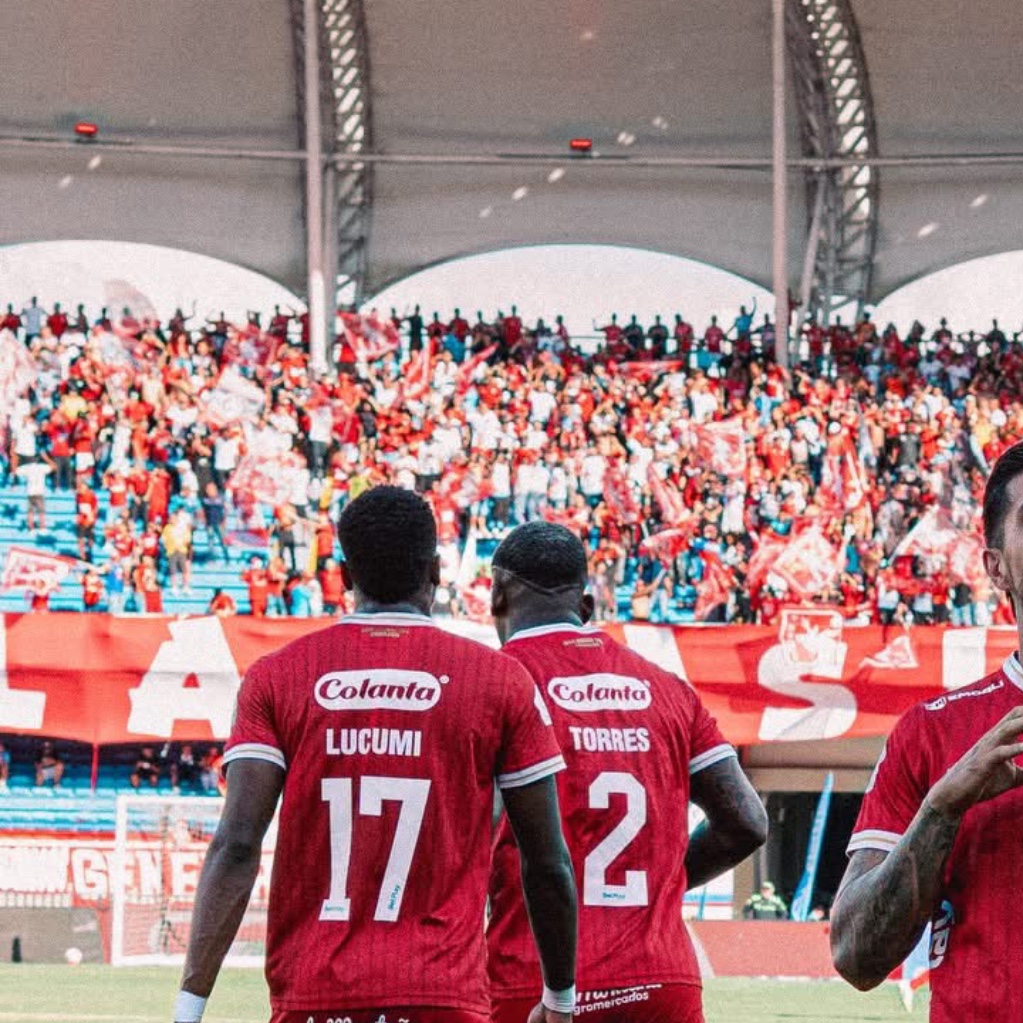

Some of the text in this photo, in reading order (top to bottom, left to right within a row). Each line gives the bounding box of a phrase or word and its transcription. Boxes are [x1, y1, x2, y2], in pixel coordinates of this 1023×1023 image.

[319, 678, 436, 701] Colanta
[553, 683, 646, 703] Colanta
[326, 728, 421, 757] LUCUMI
[569, 726, 650, 752] TORRES
[318, 775, 432, 923] 17
[583, 771, 649, 907] 2
[573, 991, 649, 1016] gromercados
